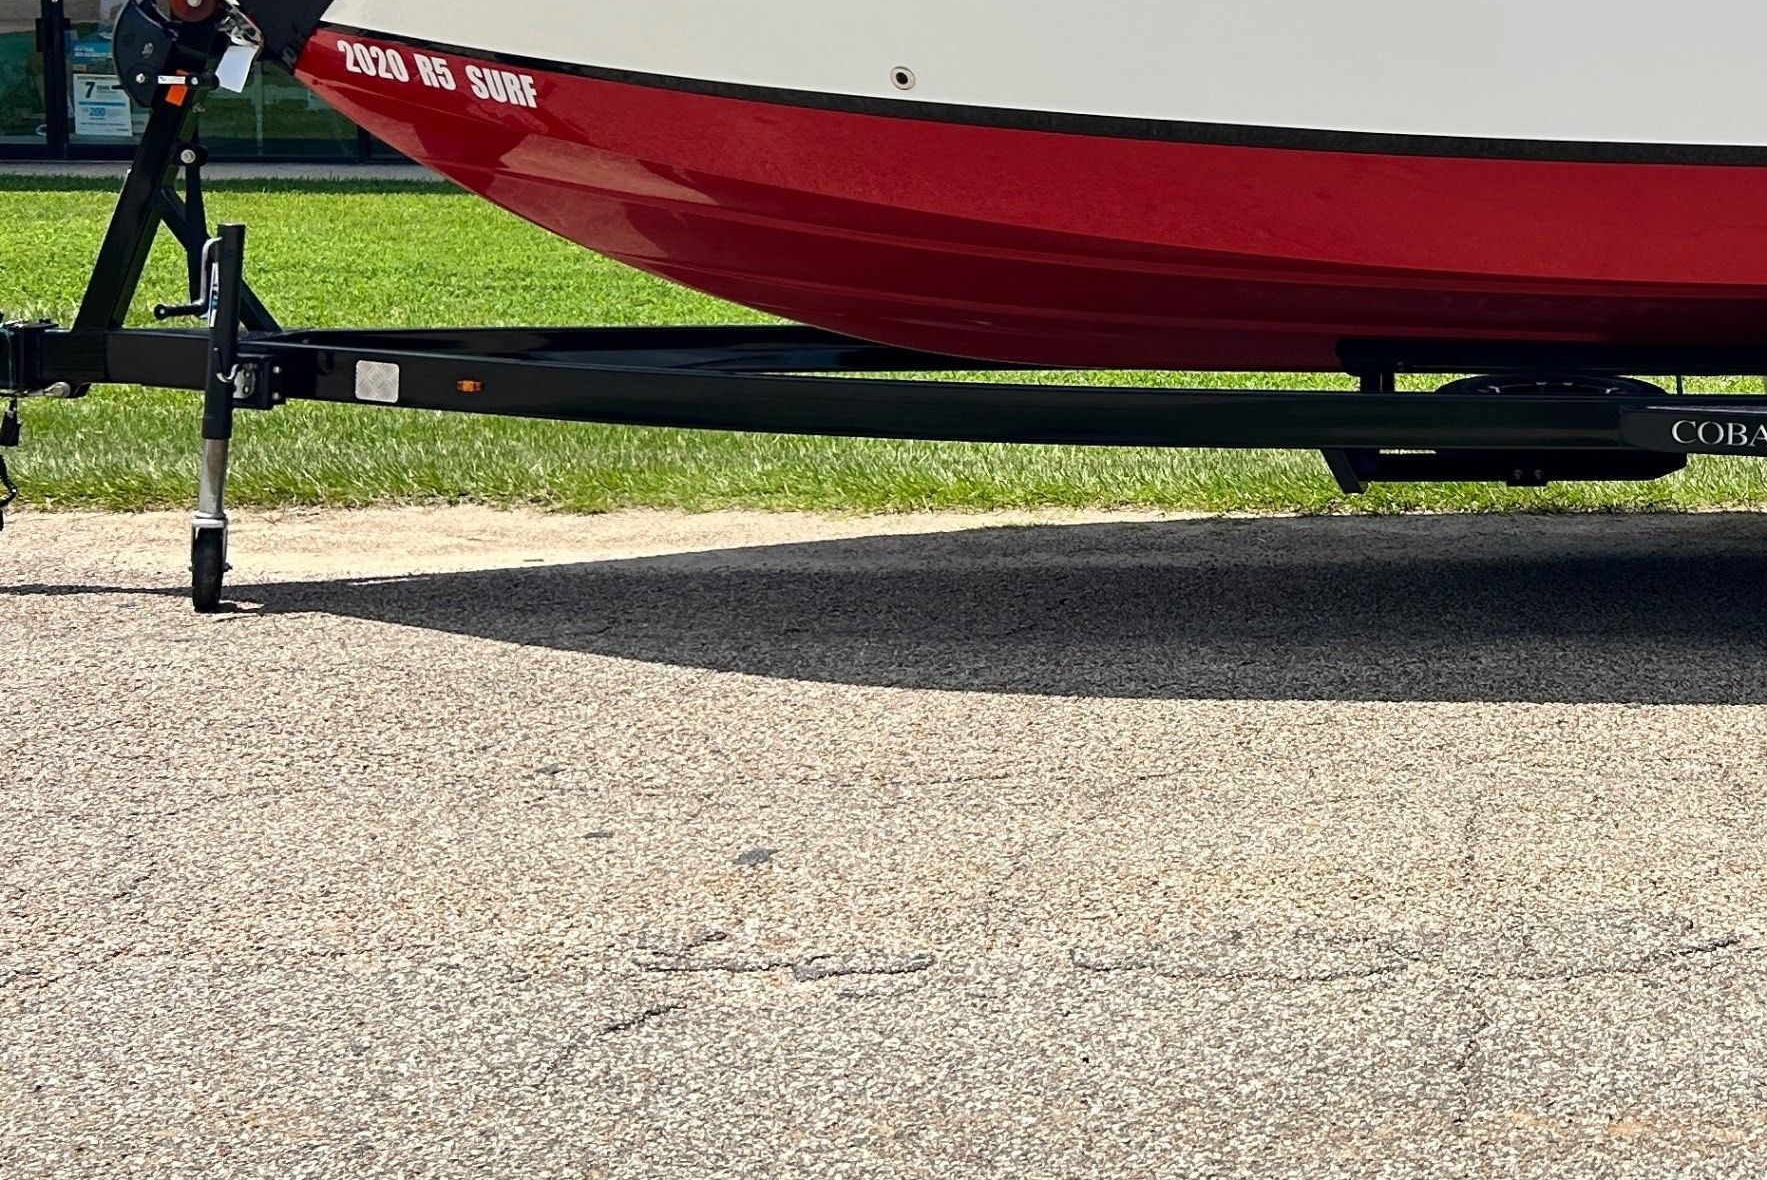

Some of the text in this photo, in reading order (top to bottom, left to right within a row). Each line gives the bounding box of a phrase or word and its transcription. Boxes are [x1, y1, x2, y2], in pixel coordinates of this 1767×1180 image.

[336, 39, 538, 109] 2020 R5 SURF
